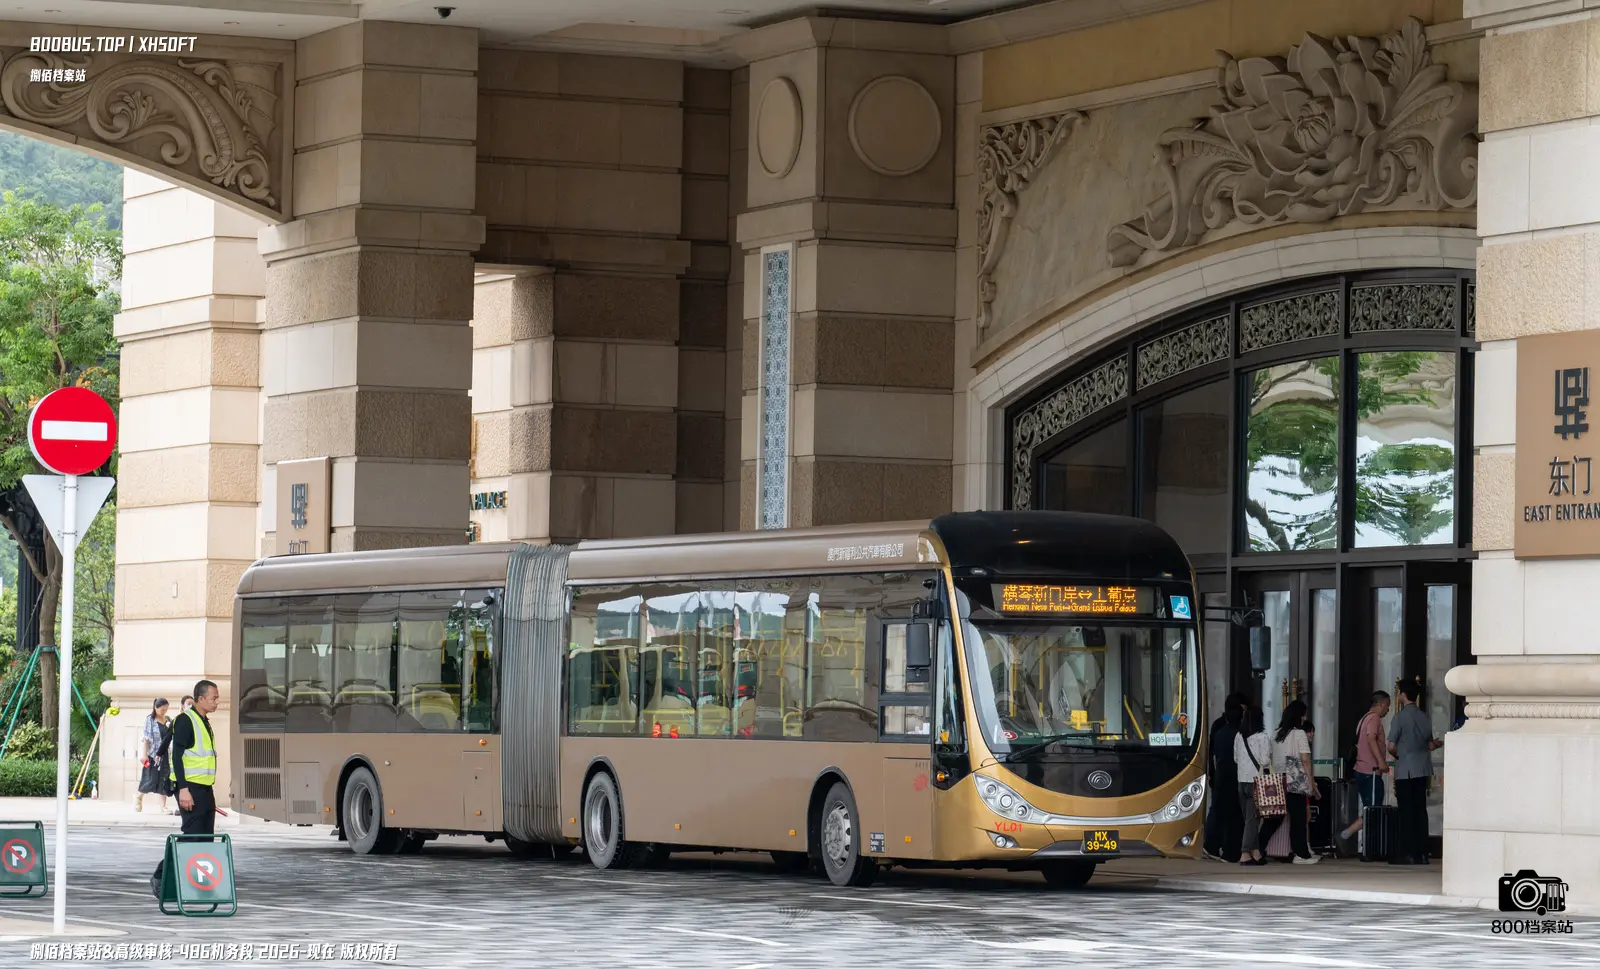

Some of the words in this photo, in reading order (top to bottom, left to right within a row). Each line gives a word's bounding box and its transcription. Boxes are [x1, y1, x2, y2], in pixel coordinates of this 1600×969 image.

[1549, 456, 1592, 496] 东门
[475, 490, 508, 510] PALACE
[1524, 505, 1552, 522] EAST
[994, 821, 1023, 832] YL01
[1095, 831, 1108, 841] MX
[1087, 840, 1117, 850] 39-49
